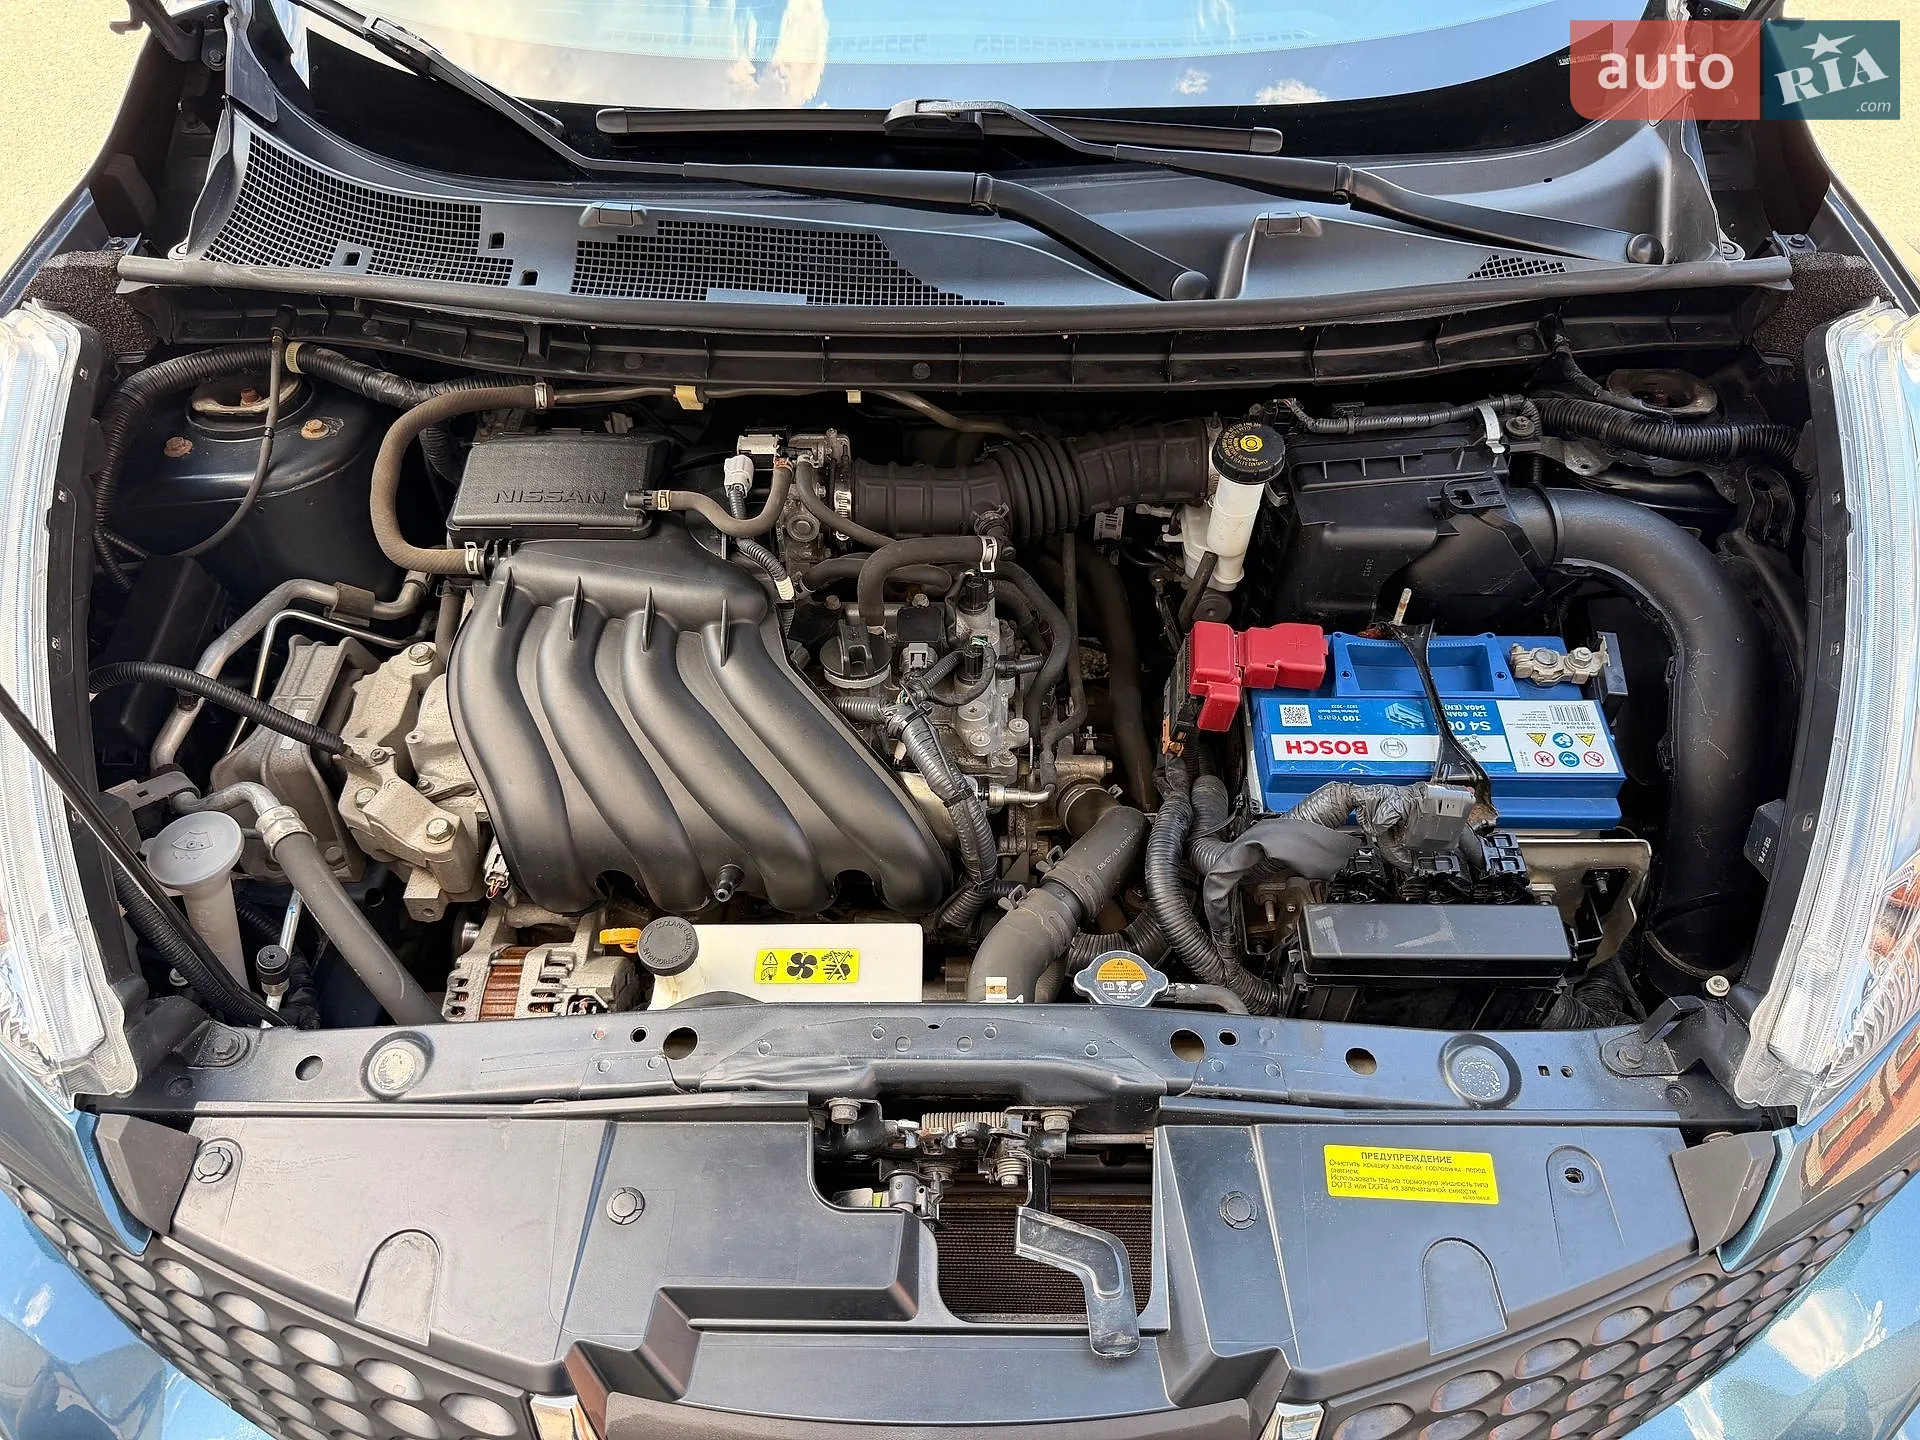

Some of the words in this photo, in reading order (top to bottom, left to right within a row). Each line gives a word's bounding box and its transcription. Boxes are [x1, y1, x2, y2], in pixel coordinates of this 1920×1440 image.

[494, 489, 607, 504] NISSAN
[1469, 720, 1492, 731] S4
[1285, 740, 1369, 755] BOSCH
[656, 920, 686, 929] COOLANT
[1329, 1159, 1361, 1168] Очистить
[1361, 1152, 1453, 1164] ПРЕДУПРЕЖДЕНИЕ
[1330, 1174, 1377, 1183] Использовать
[1402, 1178, 1439, 1186] тормозную
[1331, 1181, 1352, 1189] DOT3
[1368, 1183, 1389, 1191] DOT4
